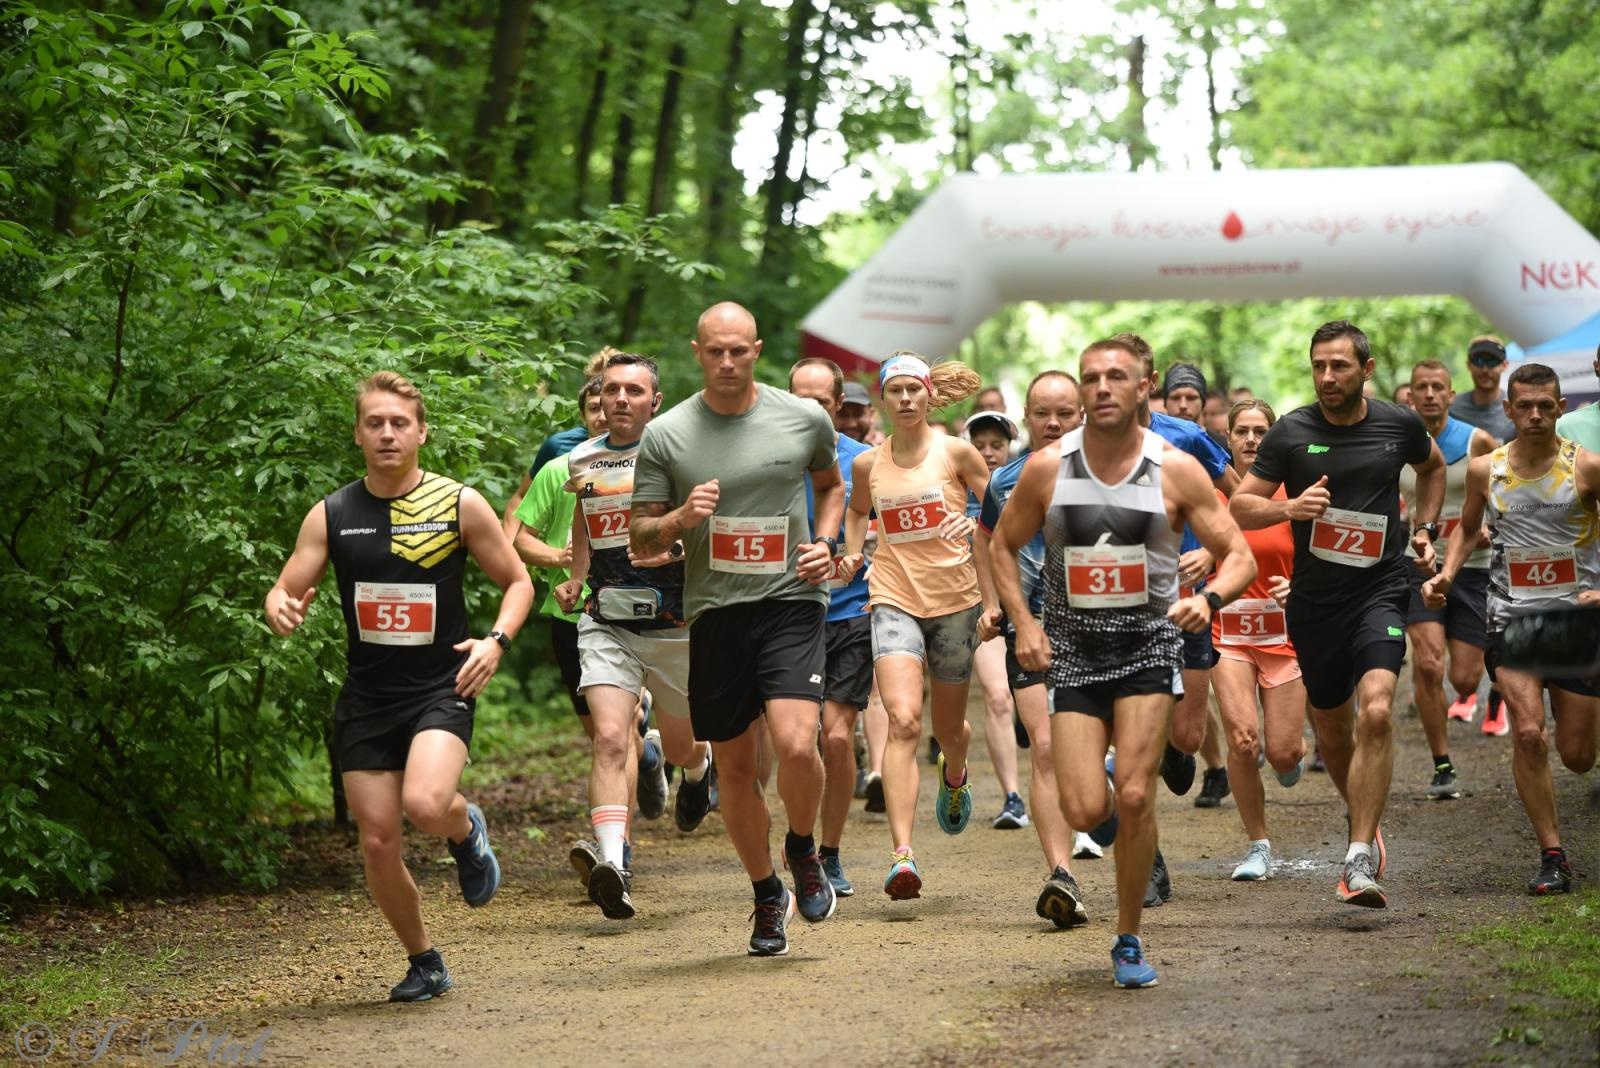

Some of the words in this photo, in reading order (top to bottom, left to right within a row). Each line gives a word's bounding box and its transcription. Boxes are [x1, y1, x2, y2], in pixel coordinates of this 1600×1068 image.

[600, 512, 629, 537] 22
[898, 506, 928, 530] 83
[733, 537, 765, 561] 15
[1333, 527, 1365, 554] 72
[1088, 567, 1125, 593] 31
[1526, 563, 1557, 585] 46
[376, 604, 411, 630] 55
[1240, 615, 1267, 635] 51
